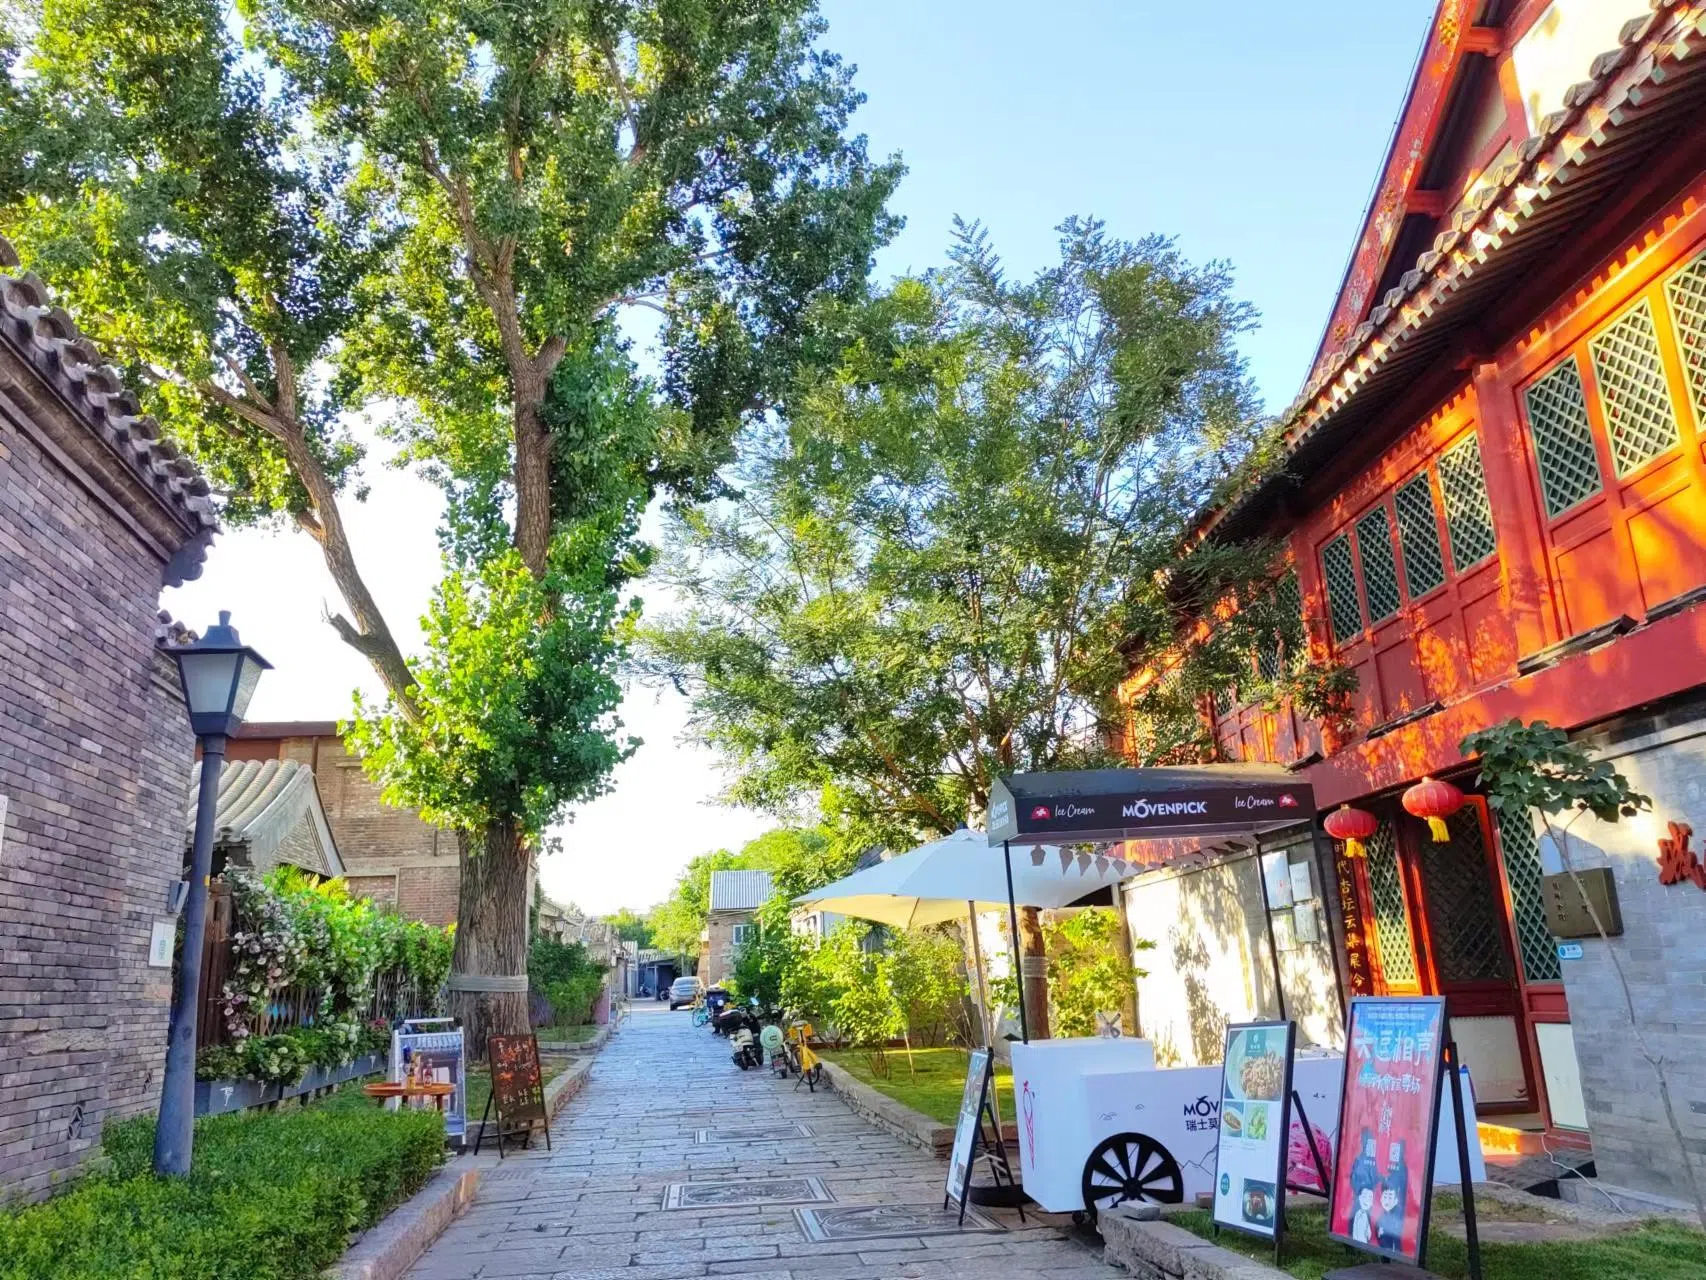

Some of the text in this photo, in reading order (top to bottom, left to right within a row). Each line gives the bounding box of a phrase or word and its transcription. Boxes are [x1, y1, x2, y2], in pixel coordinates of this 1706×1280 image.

[1235, 795, 1275, 809] Ice Cream
[1054, 803, 1096, 818] Ice Cream
